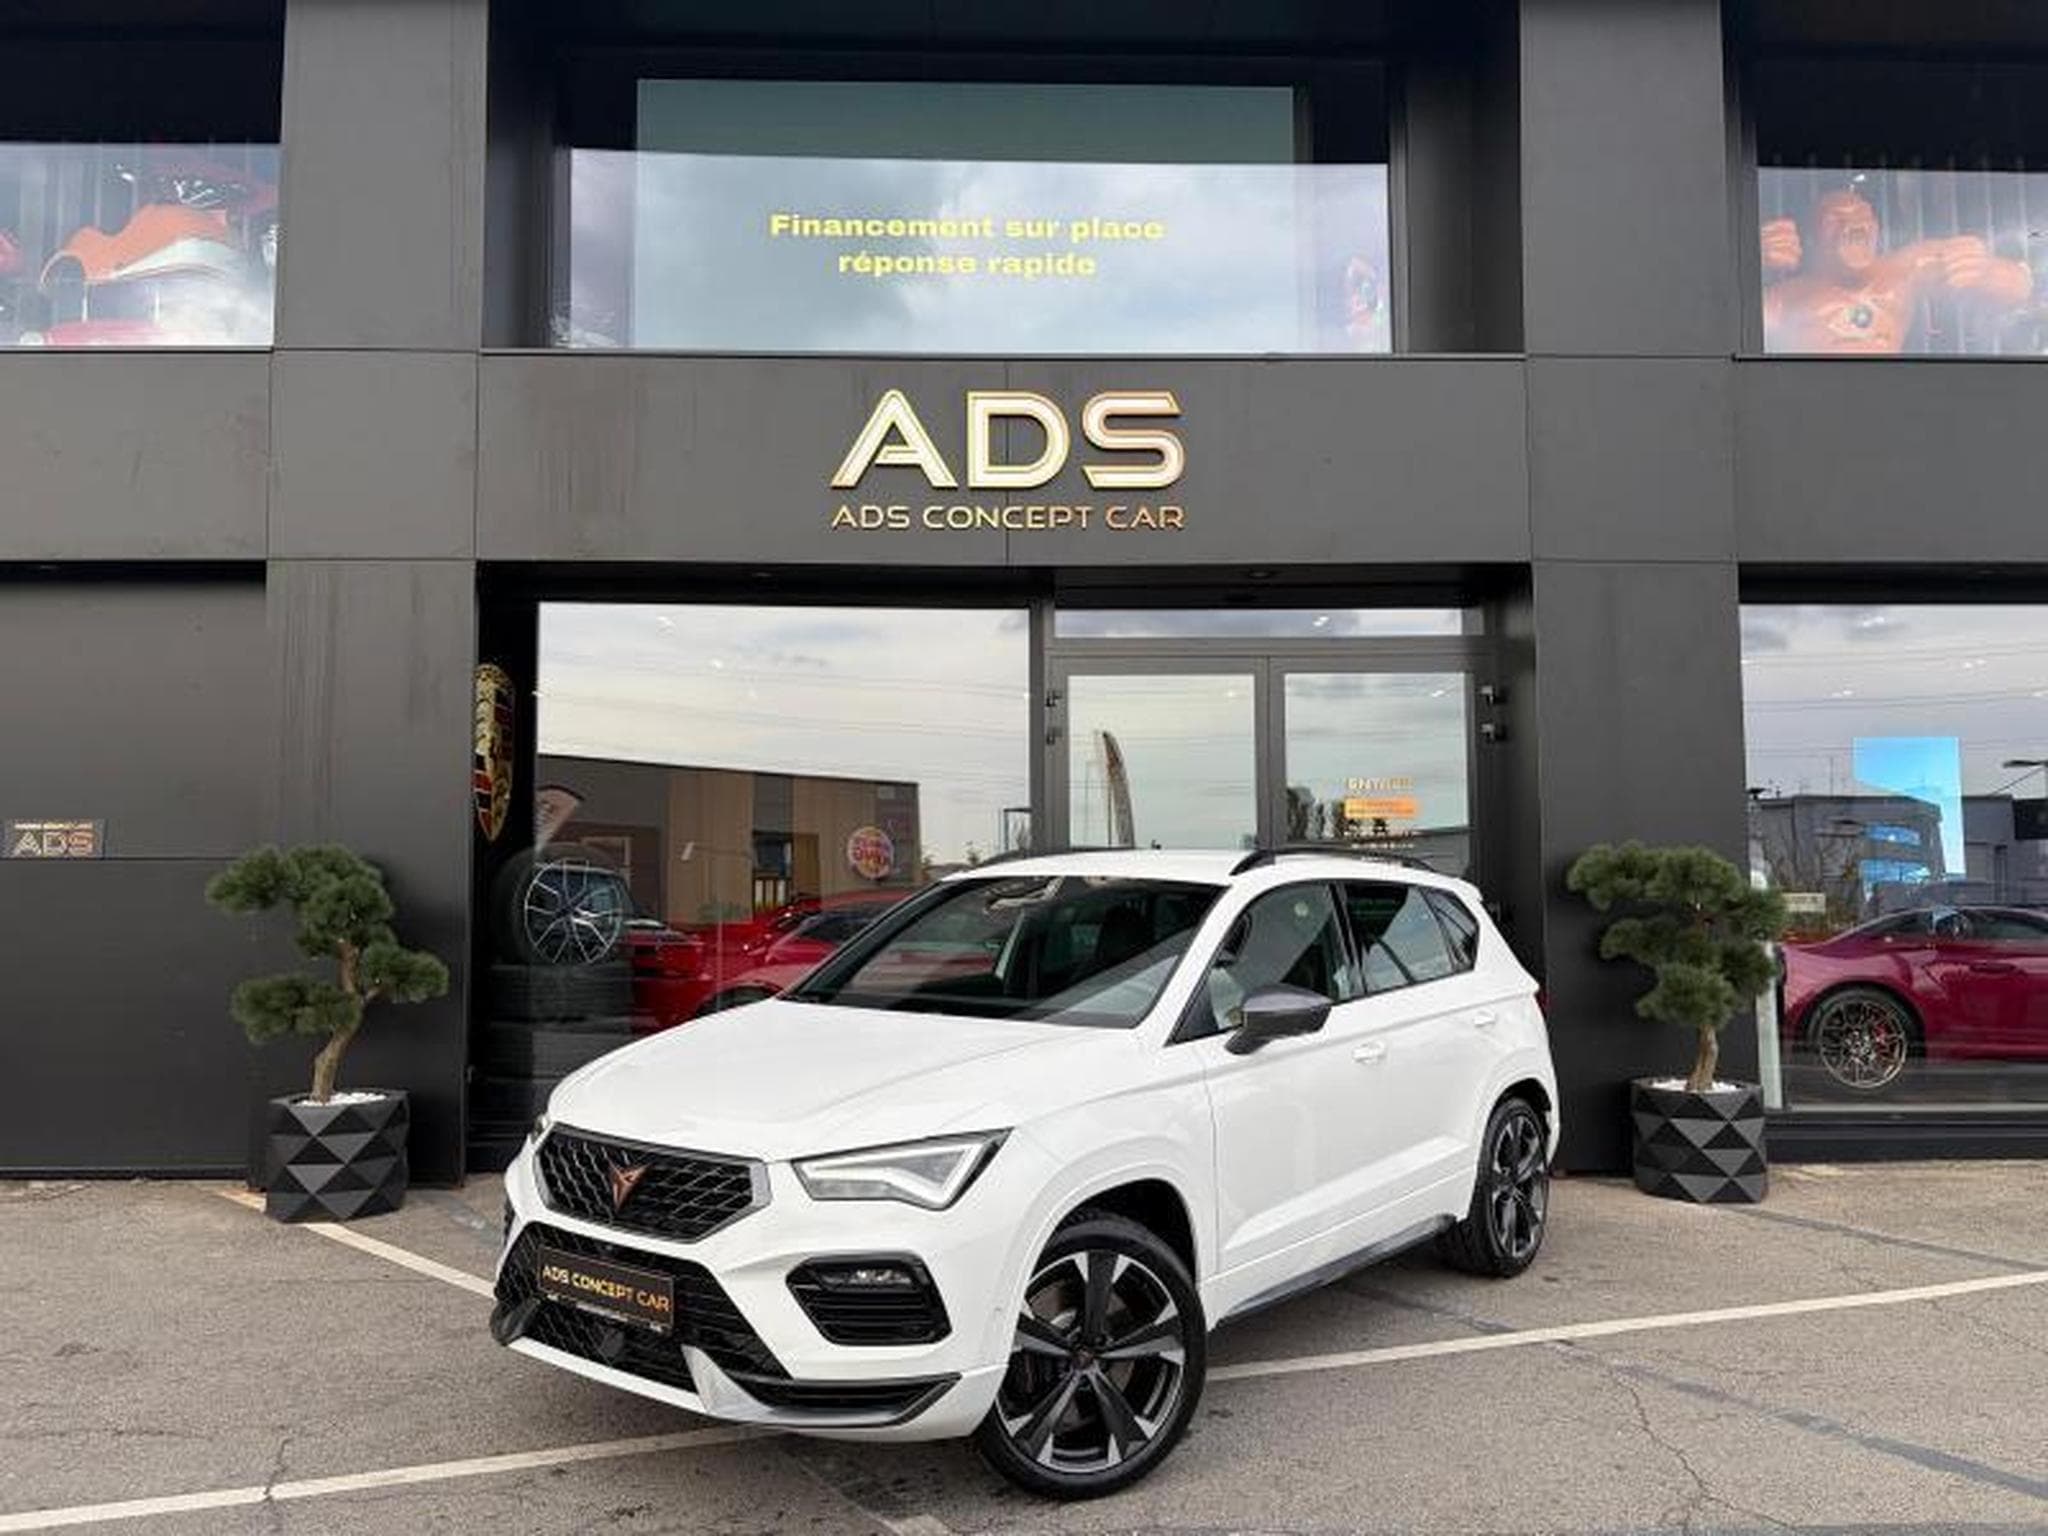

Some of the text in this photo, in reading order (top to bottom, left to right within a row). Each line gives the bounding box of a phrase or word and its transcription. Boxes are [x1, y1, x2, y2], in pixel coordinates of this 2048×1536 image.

[769, 213, 1165, 243] Financement sur place
[838, 250, 1097, 279] réponse rapide
[830, 388, 1186, 489] ADS
[831, 505, 1185, 530] ADS CONCEPT CAR
[542, 1265, 569, 1284] ADS
[571, 1273, 634, 1300] CONCEPT
[637, 1291, 669, 1312] CAR
